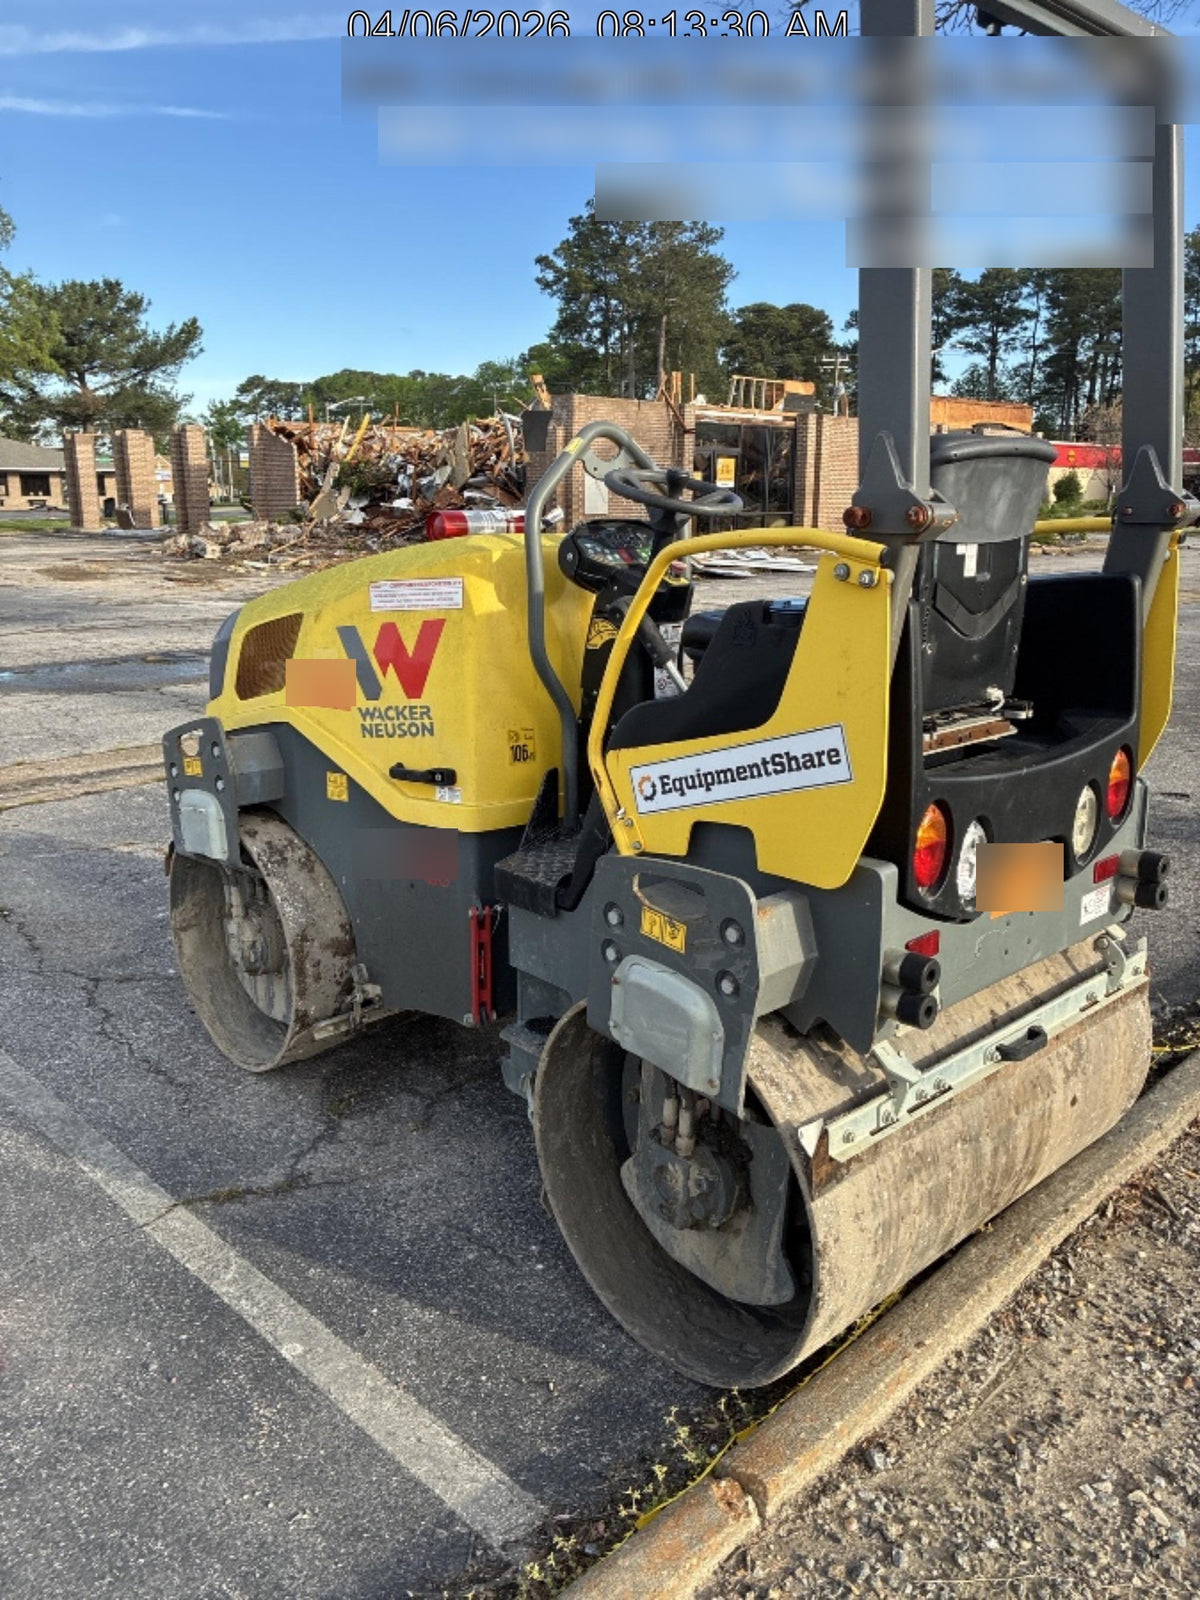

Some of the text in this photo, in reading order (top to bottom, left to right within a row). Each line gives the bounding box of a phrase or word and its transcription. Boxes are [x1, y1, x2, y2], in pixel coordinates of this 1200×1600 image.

[357, 705, 433, 722] WACKER
[360, 721, 435, 738] NEUSON
[510, 744, 529, 763] 106
[658, 747, 842, 797] EquipmentShare
